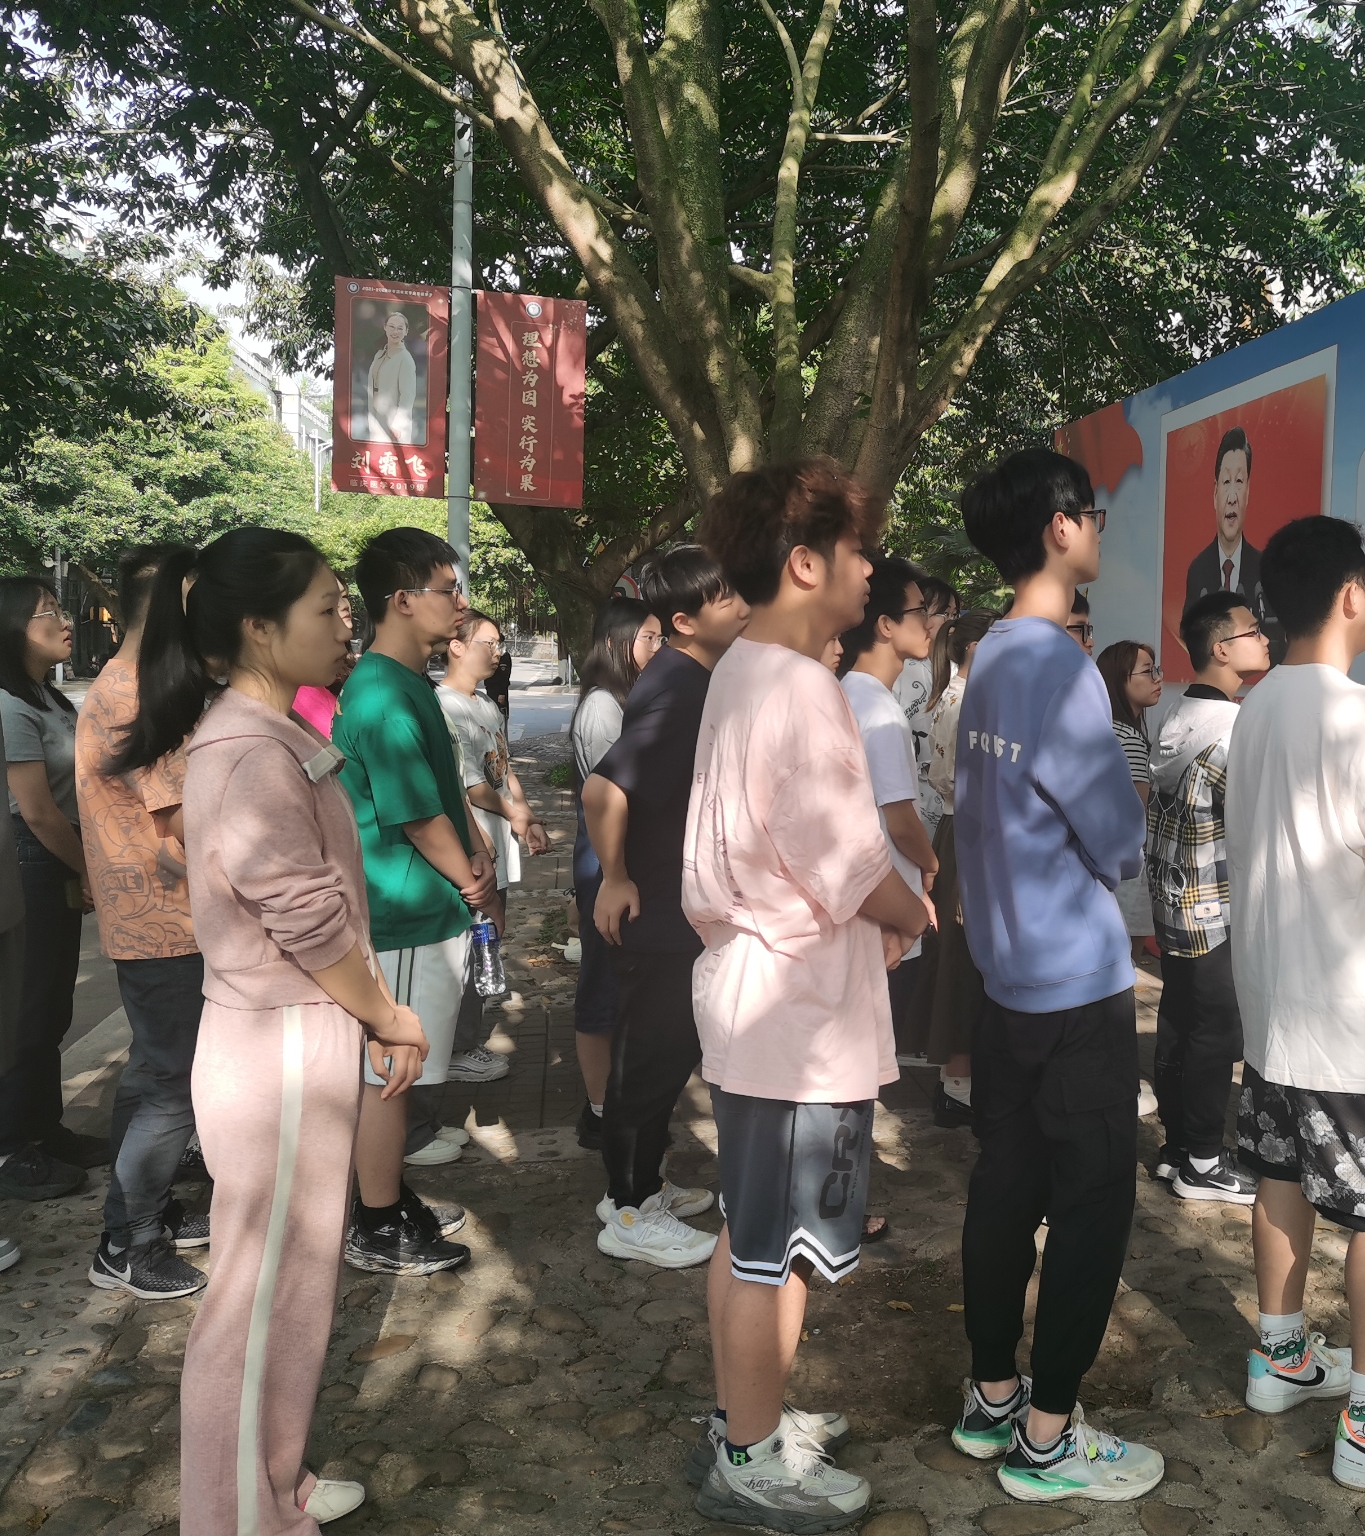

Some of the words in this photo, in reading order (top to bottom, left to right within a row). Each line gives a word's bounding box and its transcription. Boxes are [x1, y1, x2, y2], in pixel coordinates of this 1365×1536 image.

[521, 331, 541, 408] 理想为因
[351, 451, 427, 477] 刘霜飞
[519, 415, 538, 492] 实行为果
[350, 479, 425, 492] 临床医学2019级
[732, 1451, 746, 1466] R
